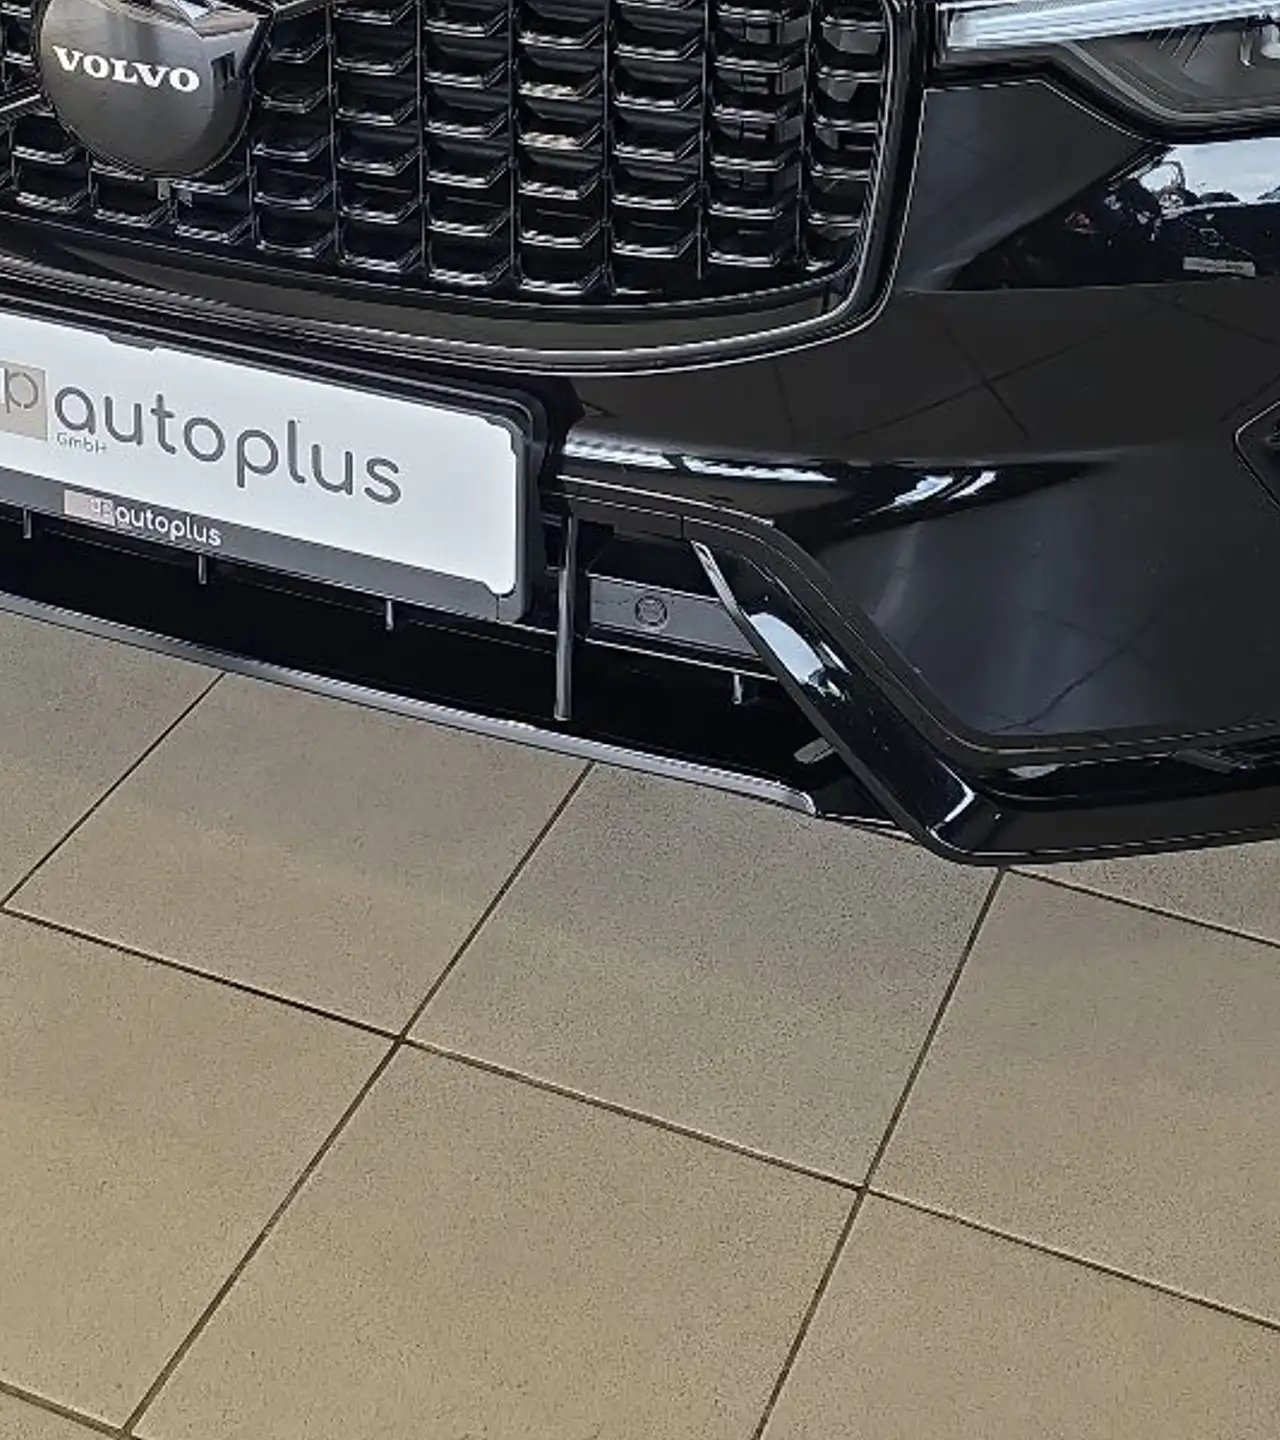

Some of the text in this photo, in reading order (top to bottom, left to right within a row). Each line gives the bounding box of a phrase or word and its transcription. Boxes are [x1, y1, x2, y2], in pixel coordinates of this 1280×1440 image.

[51, 45, 201, 93] VOLVO
[54, 386, 402, 505] autoplus
[56, 432, 108, 455] GmbH
[115, 505, 222, 547] autoplus
